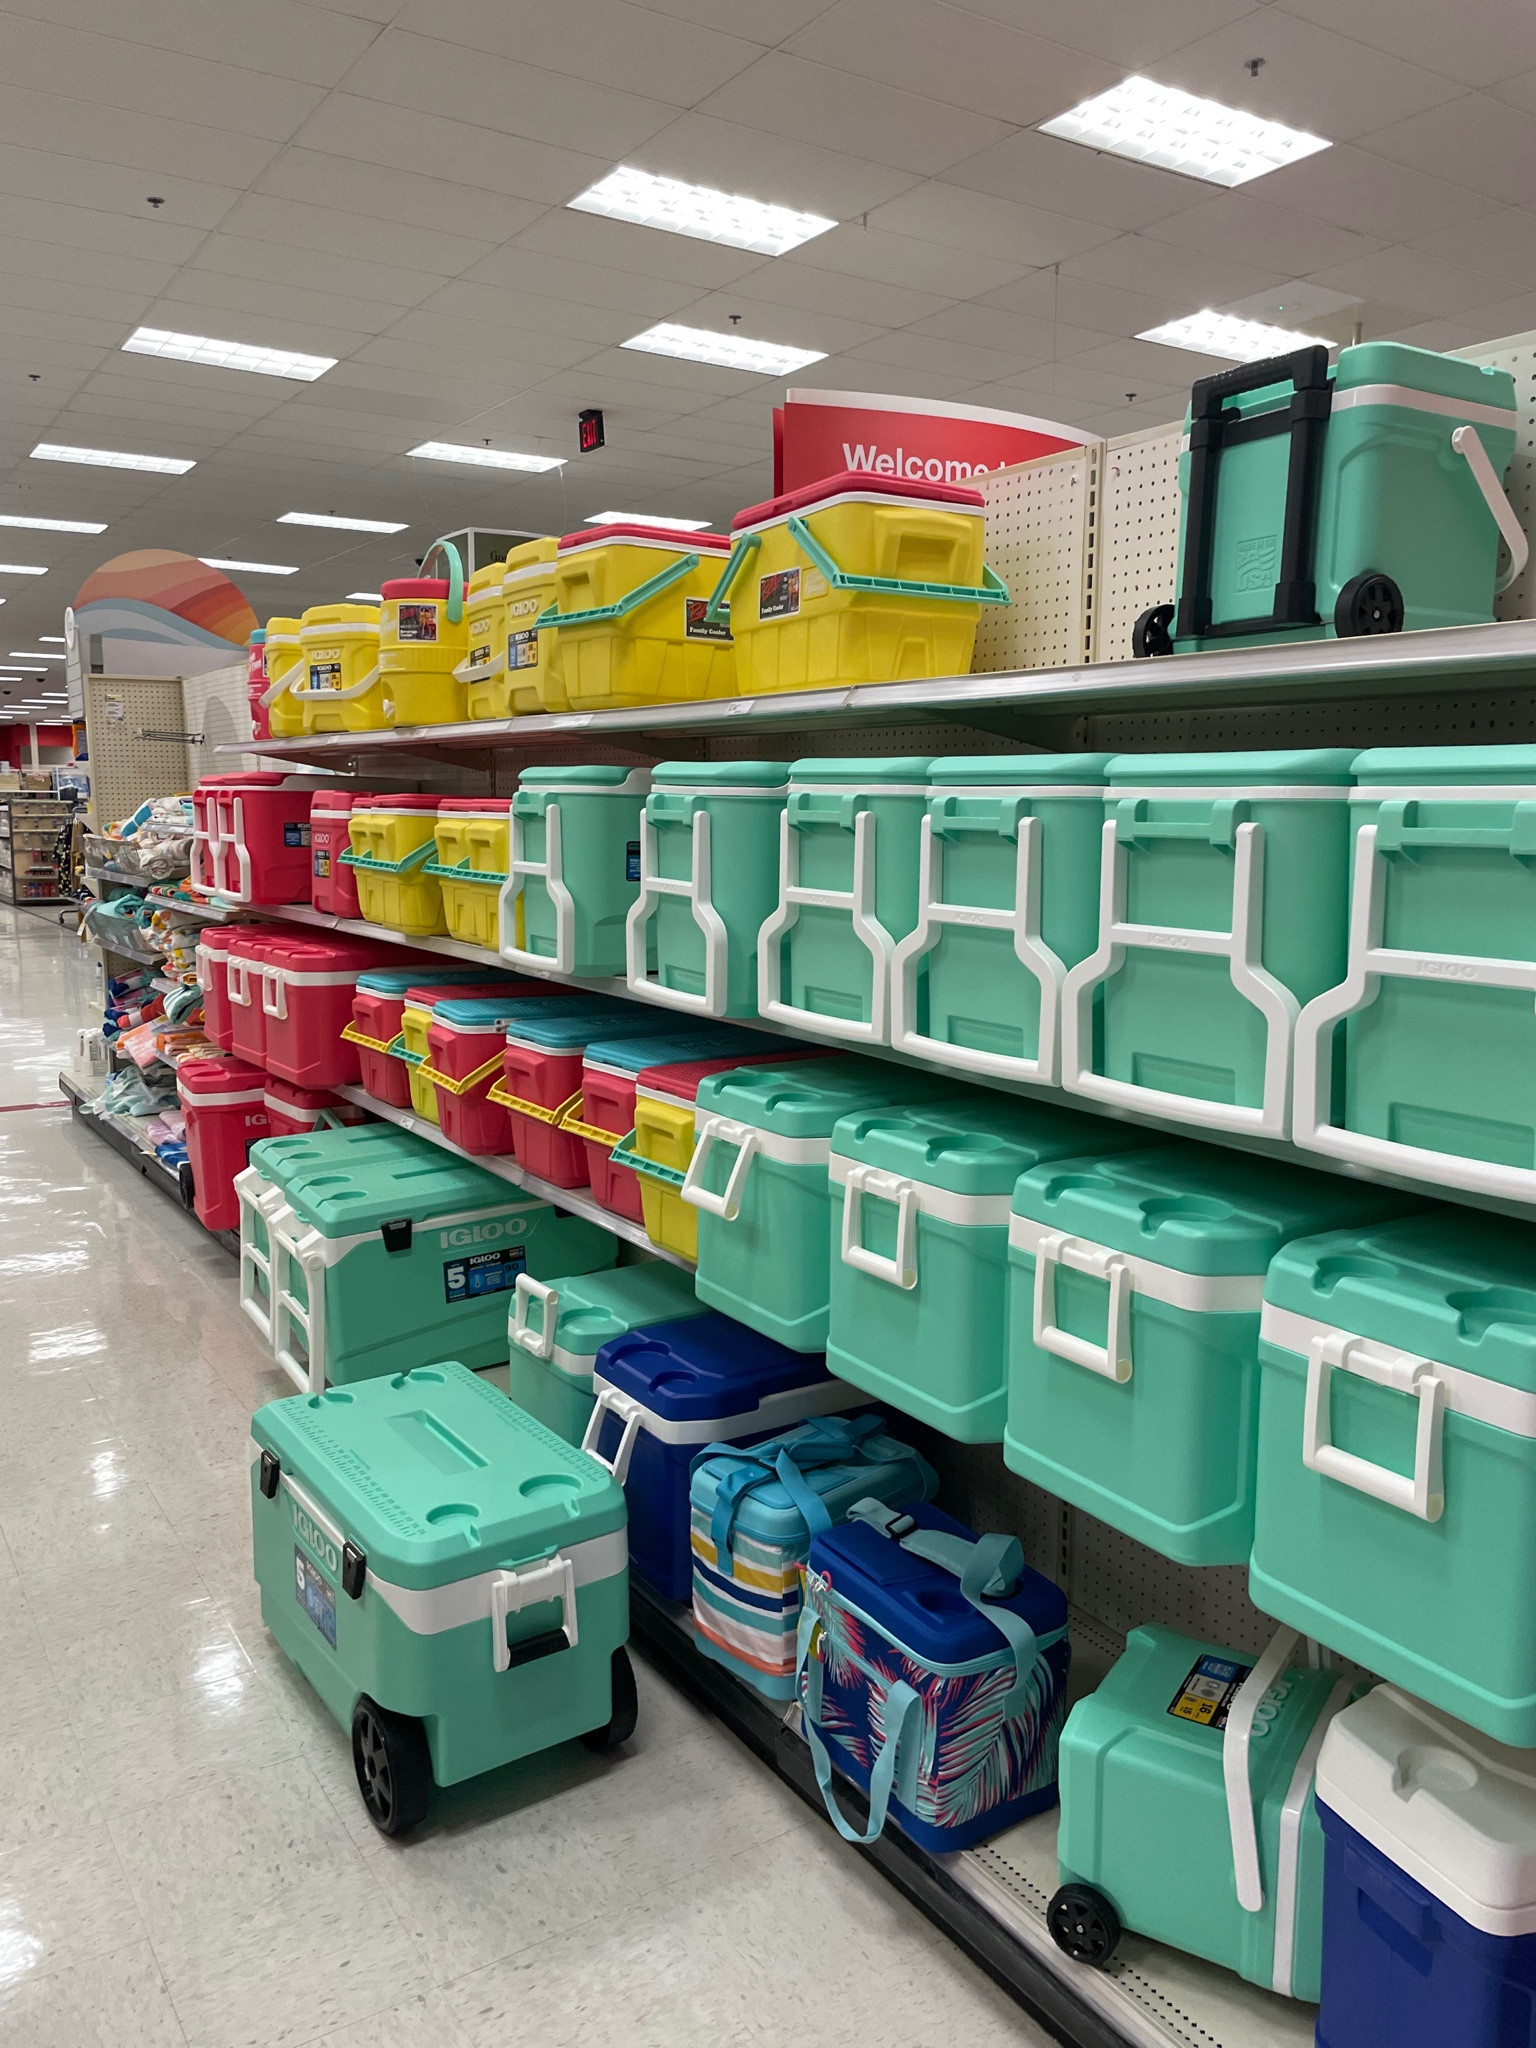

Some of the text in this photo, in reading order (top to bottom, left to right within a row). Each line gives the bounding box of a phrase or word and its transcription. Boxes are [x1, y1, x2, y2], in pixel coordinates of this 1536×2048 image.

[510, 599, 538, 617] IGLOO
[689, 626, 727, 636] Family Cooler
[312, 649, 340, 661] IGLOO
[1147, 932, 1190, 948] IGLOO
[1416, 960, 1478, 979] IGLOO
[441, 1218, 528, 1249] IGLOO
[469, 1253, 501, 1265] IGLOO
[447, 1266, 466, 1289] 5
[292, 1503, 338, 1572] IGLOO
[296, 1556, 306, 1590] 5
[1199, 1702, 1214, 1715] 16
[1249, 1680, 1293, 1737] IGLOO
